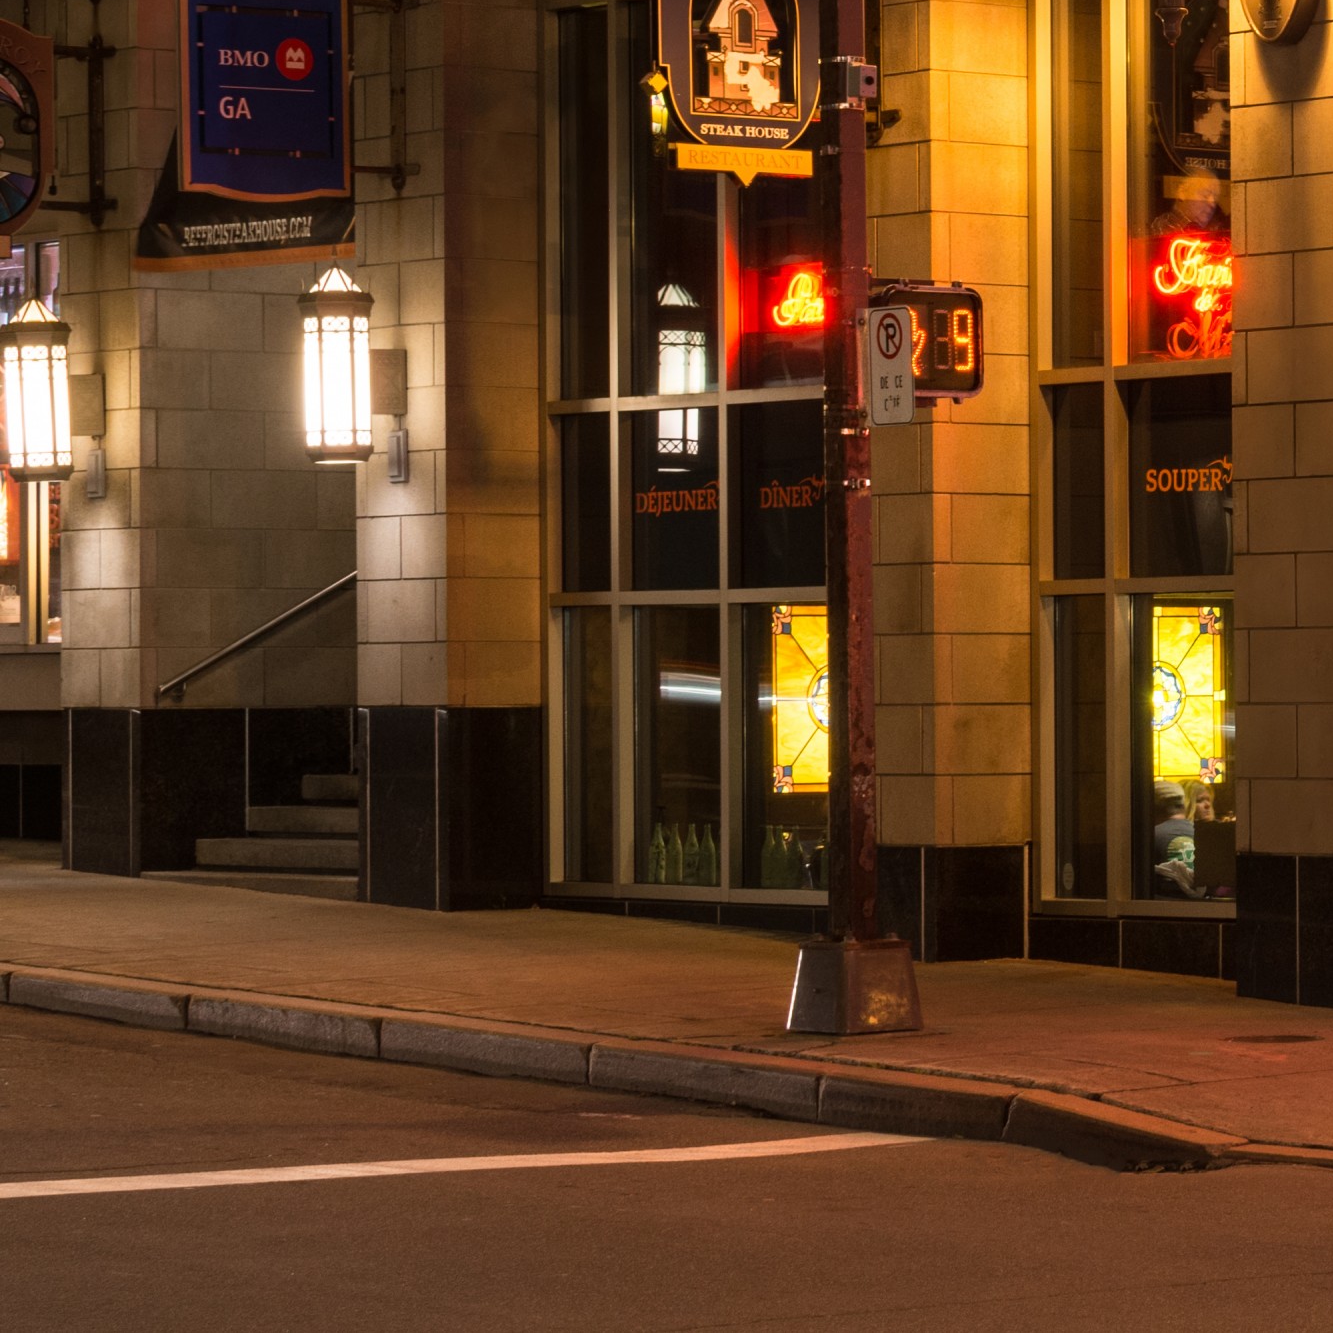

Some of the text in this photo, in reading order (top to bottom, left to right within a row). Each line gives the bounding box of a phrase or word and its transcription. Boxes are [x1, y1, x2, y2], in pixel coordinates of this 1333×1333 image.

[218, 49, 270, 68] BMO
[219, 96, 253, 120] GA
[700, 123, 790, 140] STEAK HOUSE
[688, 149, 803, 170] RESTAURANT
[1154, 238, 1232, 295] Frui
[1146, 468, 1223, 492] SOUPER
[636, 475, 717, 517] DÉJEUNER
[760, 479, 812, 508] DÎNER
